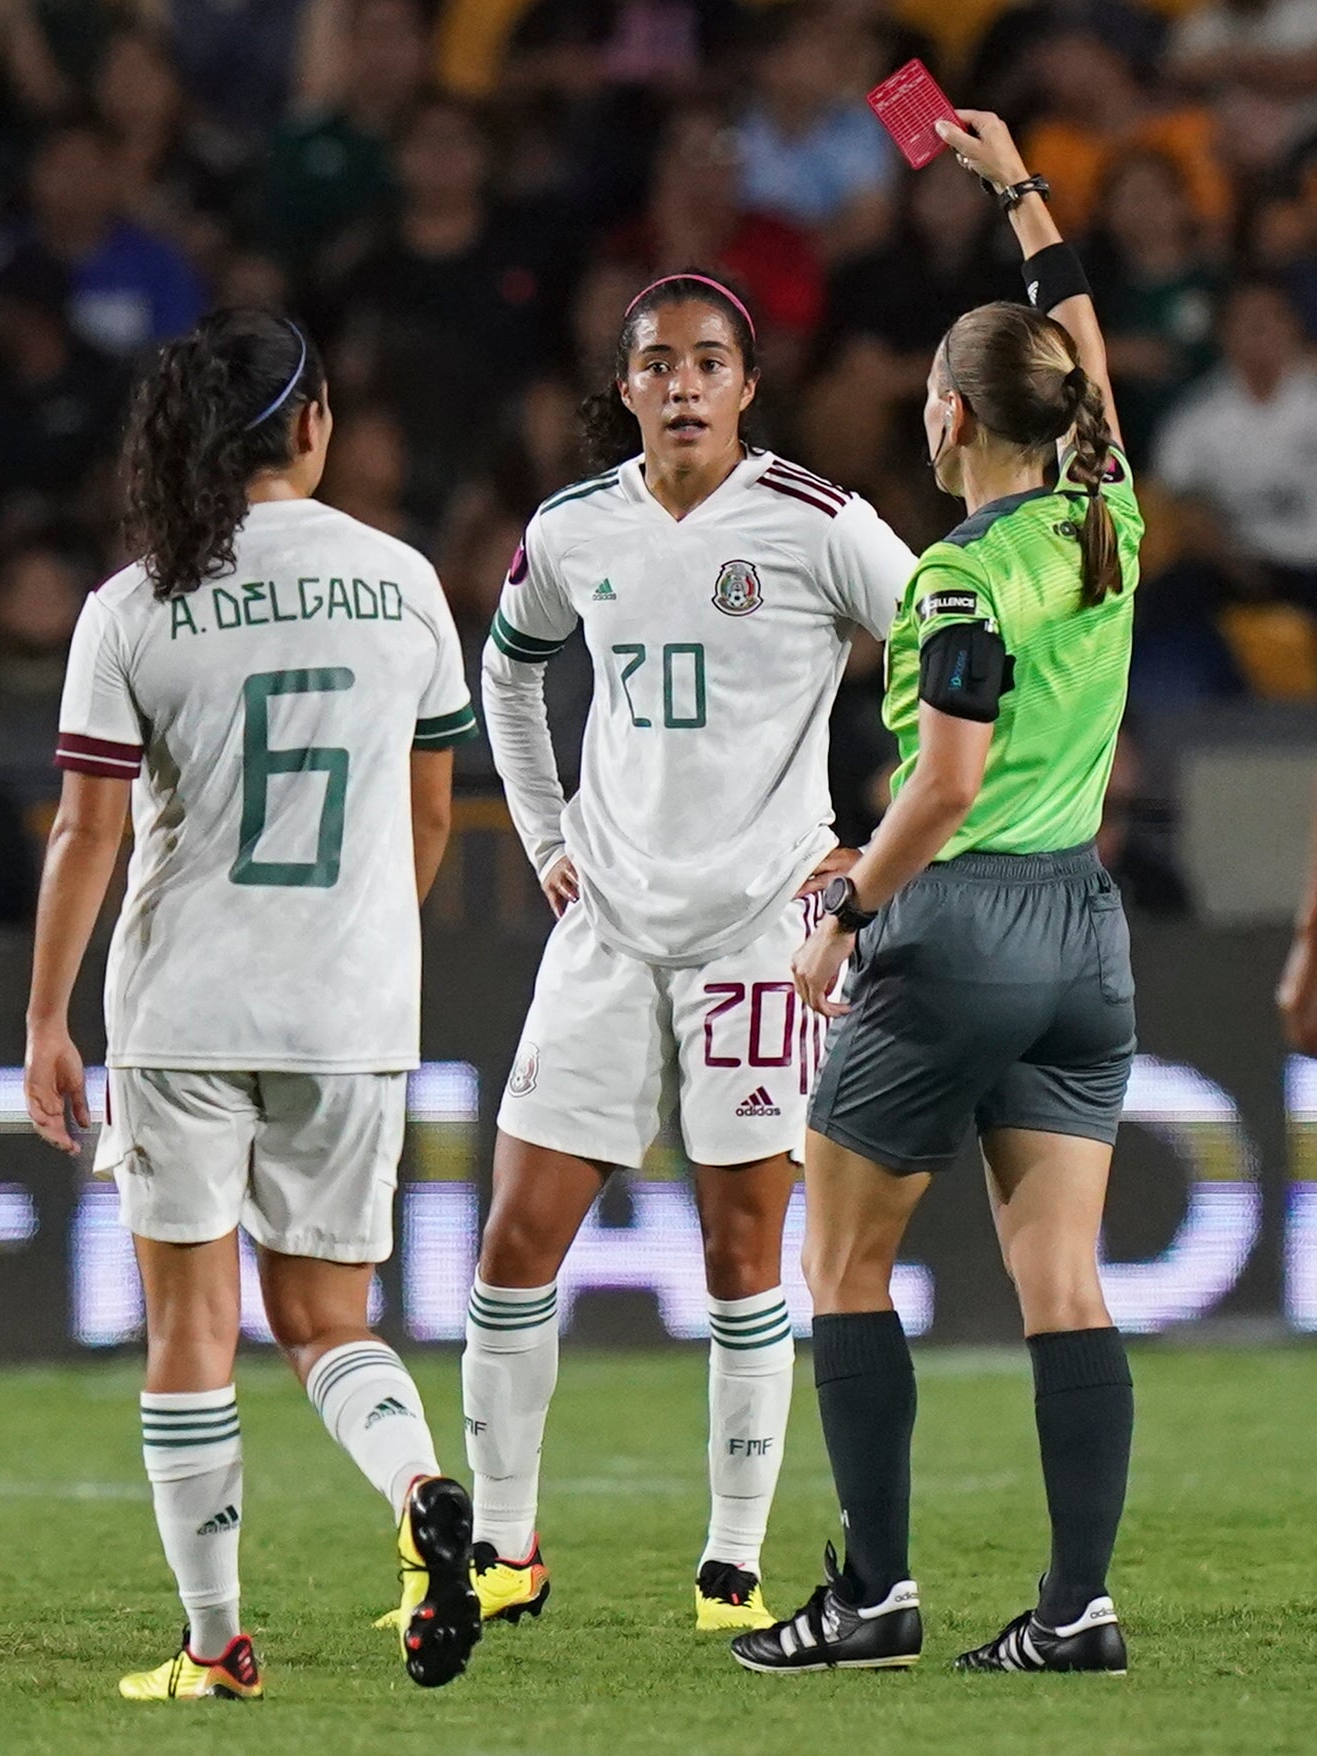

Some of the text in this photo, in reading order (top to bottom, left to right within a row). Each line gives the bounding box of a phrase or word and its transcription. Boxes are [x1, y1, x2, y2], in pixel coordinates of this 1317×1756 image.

[170, 577, 403, 640] A. DELGADO
[611, 643, 708, 729] 20
[228, 667, 356, 888] 6
[703, 981, 796, 1068] 20
[735, 1106, 781, 1117] adidas
[728, 1437, 774, 1457] FMF
